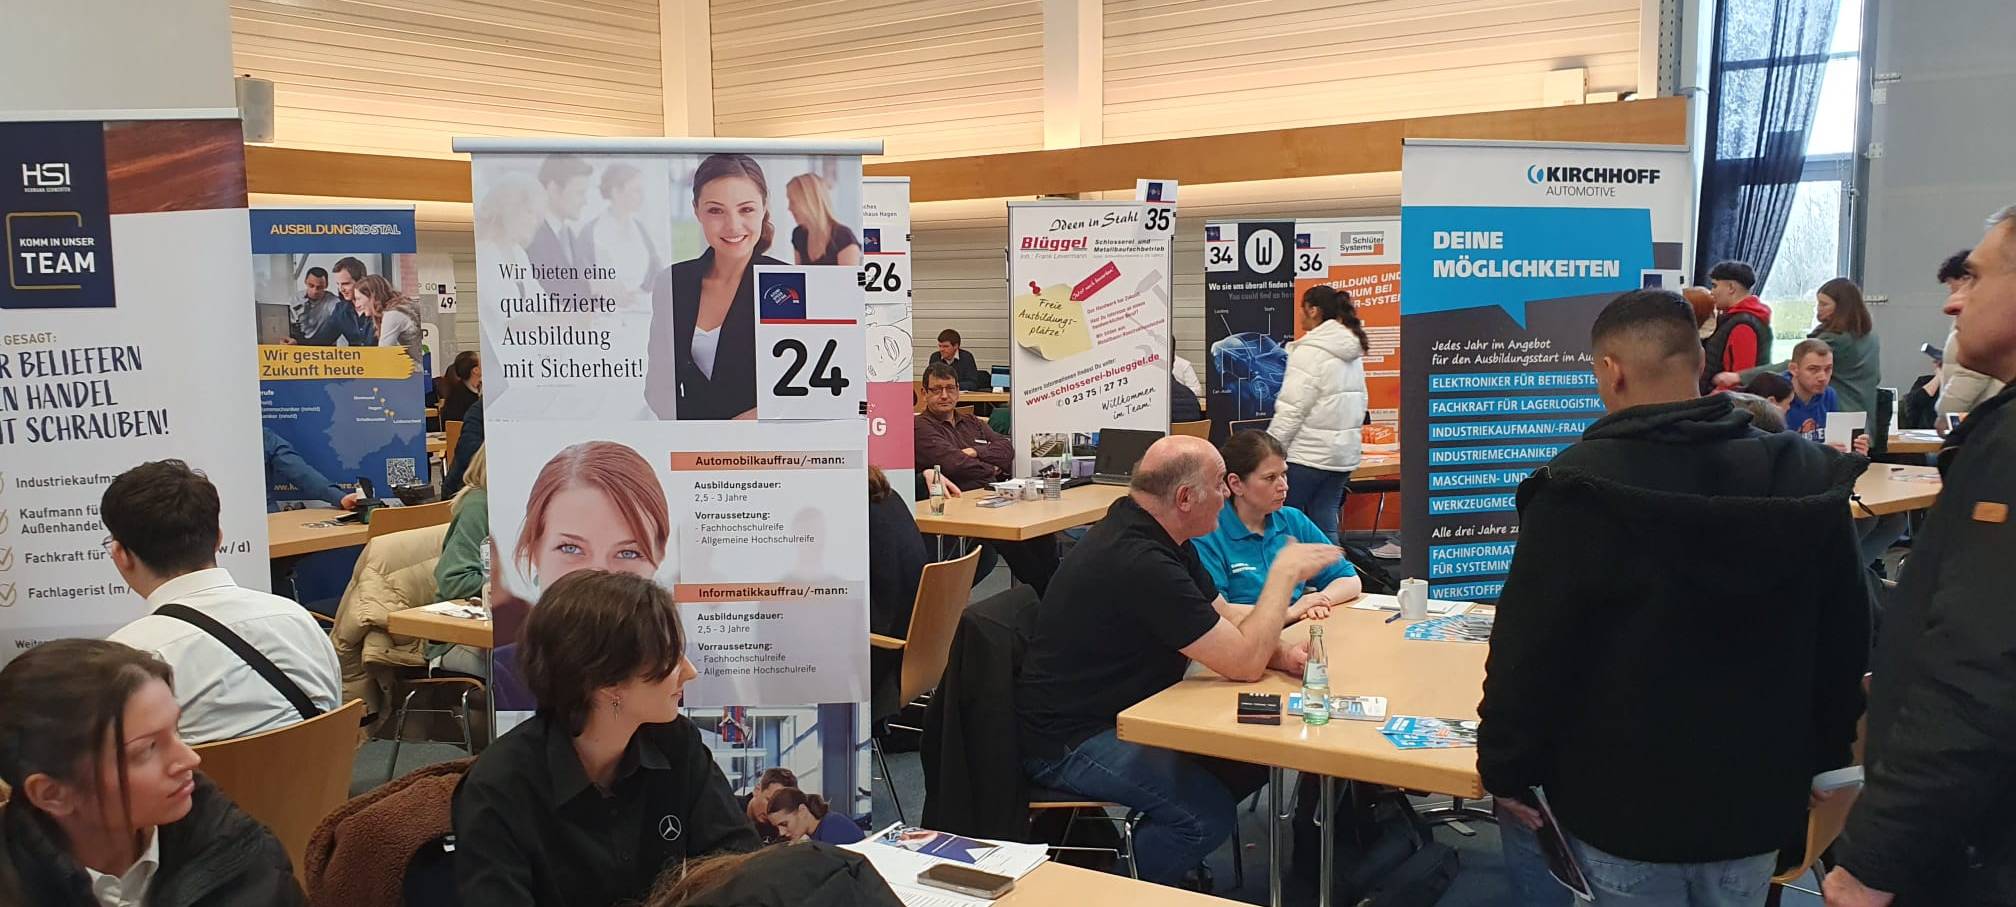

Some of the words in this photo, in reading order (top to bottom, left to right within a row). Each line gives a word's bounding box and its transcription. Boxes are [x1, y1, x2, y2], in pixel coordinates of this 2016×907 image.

[22, 163, 71, 186] HSI
[1547, 166, 1660, 184] KIRCHHOFF
[1546, 185, 1616, 197] AUTOMOTIVE
[1049, 219, 1085, 232] Ideen
[1089, 218, 1099, 228] in
[1101, 211, 1138, 227] Stahl
[1144, 208, 1171, 230] 35
[20, 238, 49, 247] KOMM
[50, 238, 60, 246] IN
[62, 237, 95, 246] UNSER
[1021, 236, 1088, 251] Blüggel
[1352, 235, 1384, 244] Schlüter
[1433, 231, 1504, 250] DEINE
[1340, 244, 1373, 252] Systems
[1210, 246, 1233, 265] 34
[1299, 253, 1323, 271] 36
[21, 252, 96, 274] TEAM
[1433, 255, 1620, 278] MÖGLICHKEITEN
[499, 264, 526, 280] Wir
[532, 264, 578, 280] bieten
[584, 264, 616, 280] eine
[864, 262, 902, 292] 26
[1375, 284, 1392, 293] BEI
[440, 297, 453, 309] 49
[500, 293, 616, 318] qualifizierte
[1040, 299, 1063, 310] Freie
[4, 332, 57, 345] GESAGT:
[502, 326, 611, 350] Ausbildung
[1432, 340, 1461, 351] Jedes
[1464, 339, 1488, 350] Jahr
[1491, 339, 1505, 349] im
[1507, 337, 1551, 352] Angebot
[18, 346, 142, 378] BELIEFERN
[264, 350, 288, 361] Wir
[293, 349, 361, 363] gestalten
[1432, 354, 1448, 365] für
[1452, 353, 1471, 364] den
[1474, 352, 1559, 366] Ausbildungsstart
[1562, 352, 1575, 362] im
[263, 365, 319, 376] Zukunft
[324, 364, 365, 376] heute
[503, 359, 534, 378] mit
[541, 358, 643, 378] Sicherheit!
[772, 339, 850, 397] 24
[1025, 353, 1160, 406] www.schlosserei-blueggel.de
[1432, 376, 1511, 388] ELEKTRONIKER
[1514, 373, 1535, 386] FÜR
[26, 380, 118, 410] HANDEL
[1072, 392, 1084, 403] 23
[1086, 388, 1097, 397] 75
[1104, 382, 1114, 392] 27
[1117, 377, 1128, 387] 73
[1102, 386, 1156, 411] Willkommen
[1432, 401, 1494, 413] FACHKRAFT
[1497, 398, 1518, 411] FÜR
[1521, 398, 1600, 410] LAGERLOGISTIK
[1113, 411, 1124, 419] im
[26, 409, 170, 443] SCHRAUBEN!
[1432, 422, 1585, 438] INDUSTRIEKAUFMANN/-FRAU
[695, 455, 845, 467] Automobilkauffrau/-mann:
[1432, 447, 1558, 462] INDUSTRIEMECHANIKER
[694, 481, 782, 491] Ausbildungsdauer:
[1432, 474, 1500, 487] MASCHINEN-
[695, 493, 709, 503] 2,5
[717, 493, 723, 502] 3
[725, 492, 748, 502] Jahre
[1432, 497, 1515, 511] WERKZEUGMEC
[20, 503, 83, 519] Kaufmann
[87, 504, 98, 516] fü
[695, 511, 770, 520] Vorraussetzung:
[21, 520, 104, 534] Außenhandel
[701, 523, 784, 532] Fachhochschulreife
[1432, 526, 1452, 538] Alle
[1455, 525, 1475, 537] drei
[1477, 524, 1507, 535] Jahre
[701, 536, 749, 546] Allgemeine
[751, 535, 815, 544] Hochschulreife
[25, 551, 84, 563] Fachkraft
[88, 550, 106, 560] für
[1432, 545, 1516, 560] FACHINFORMAT
[1433, 562, 1453, 575] FÜR
[28, 585, 105, 599] Fachlagerist
[699, 586, 848, 598] Informatikkauffrau/-mann:
[1432, 584, 1504, 599] WERKSTOFFP
[697, 612, 784, 622] Ausbildungsdauer:
[697, 625, 711, 634] 2,5
[719, 625, 725, 633] 3
[727, 625, 750, 634] Jahre
[697, 642, 773, 651] Vorraussetzung:
[703, 654, 786, 663] Fachhochschulreife
[704, 667, 750, 676] Allgemeine
[753, 664, 817, 674] Hochschulreife
